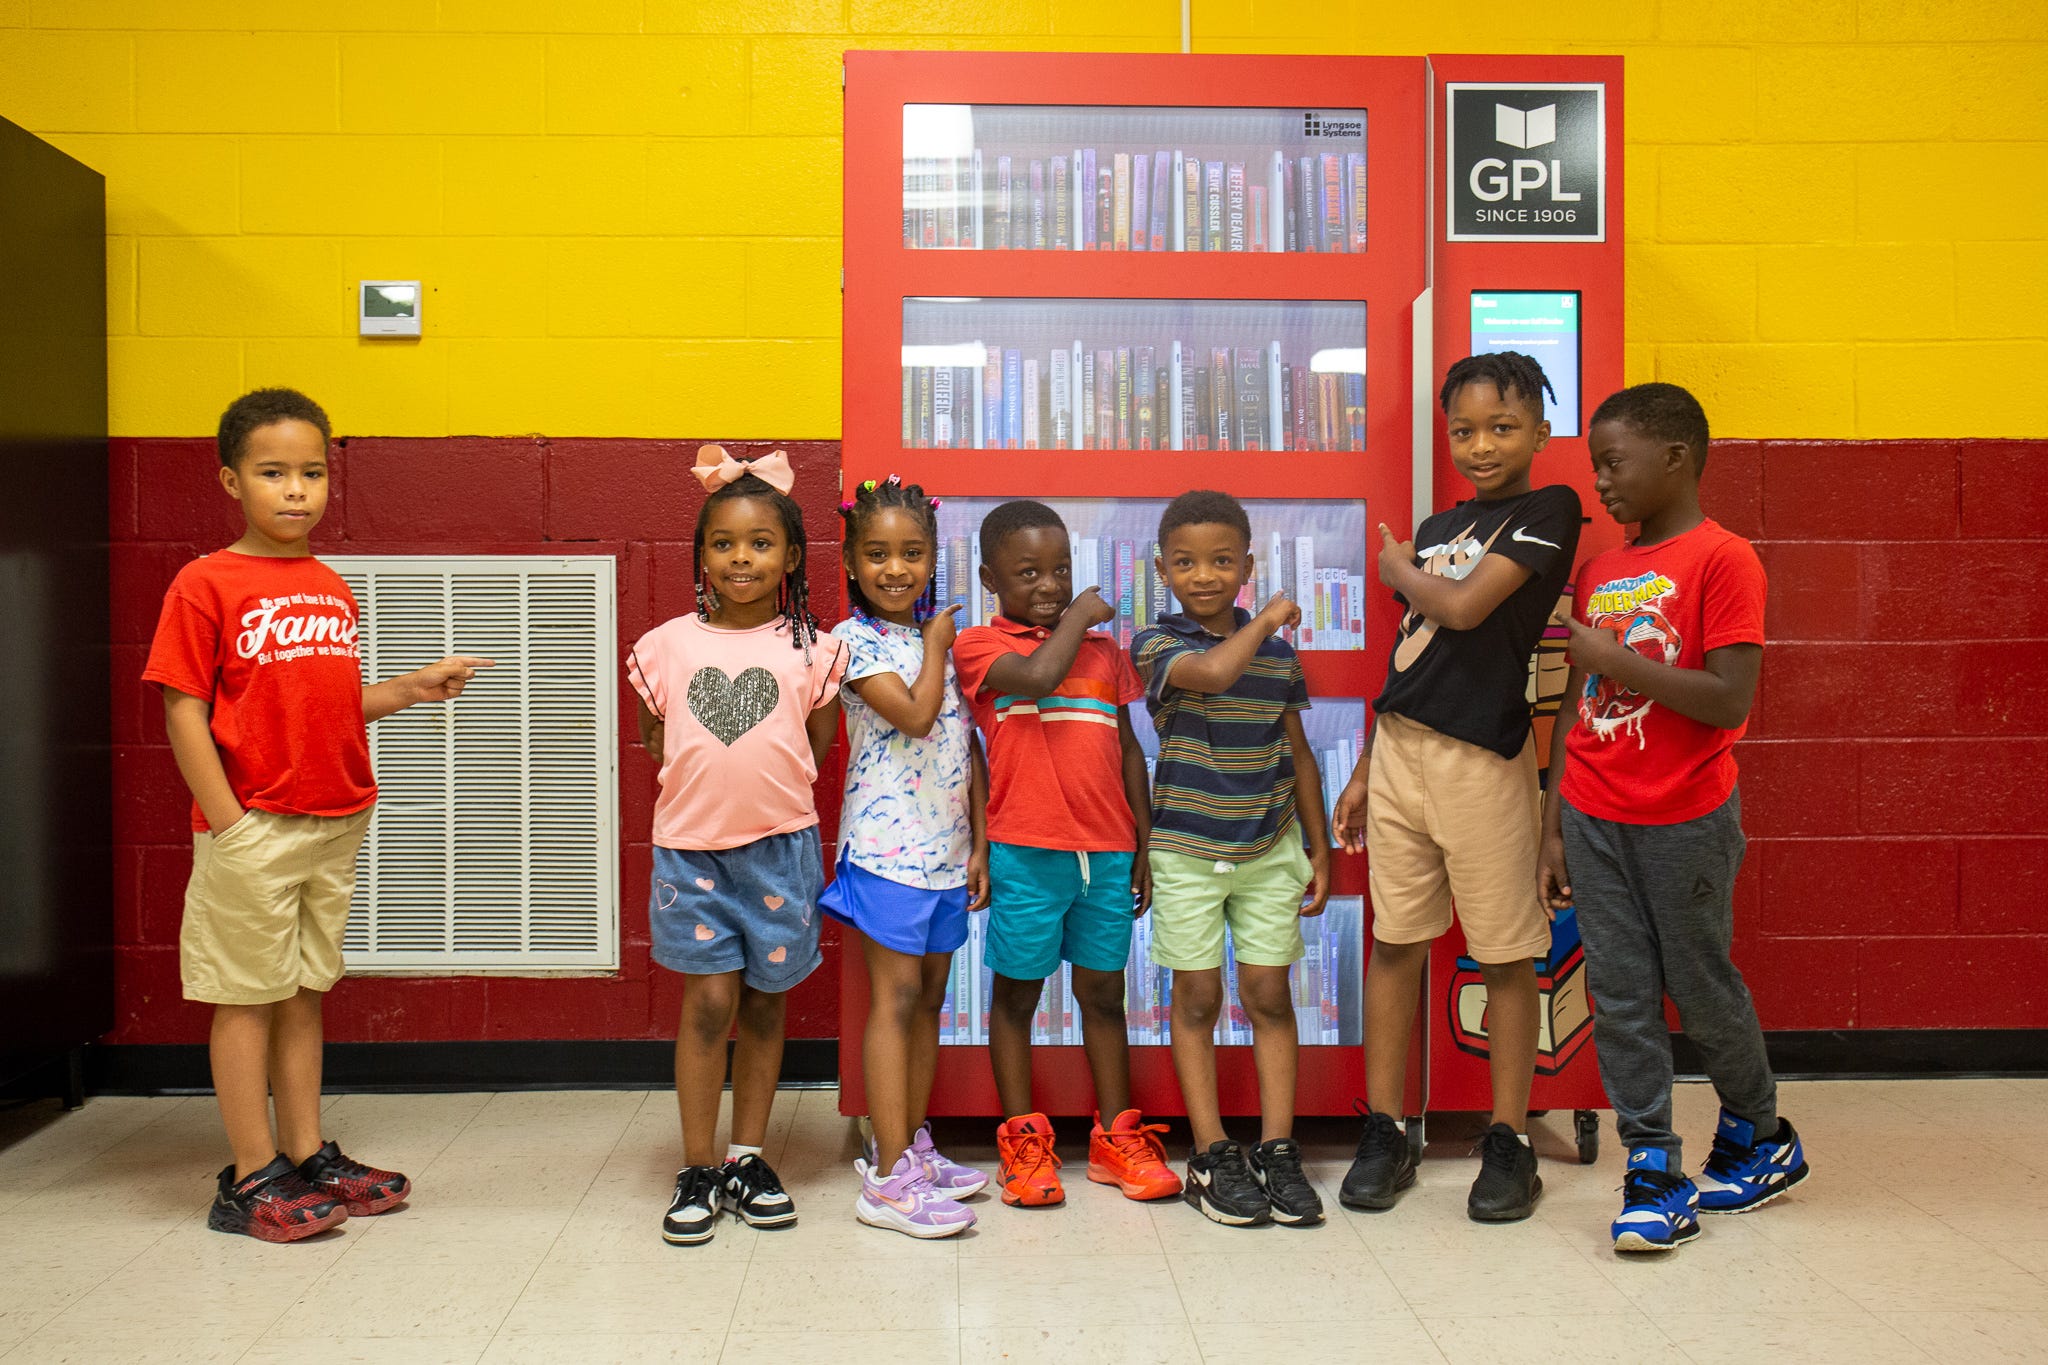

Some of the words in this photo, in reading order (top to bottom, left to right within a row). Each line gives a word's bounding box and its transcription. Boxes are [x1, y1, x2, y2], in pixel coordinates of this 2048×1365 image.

[1322, 121, 1361, 130] Lyngsoe
[1322, 129, 1361, 138] Systems
[1056, 170, 1066, 203] SANDRA
[1209, 168, 1219, 192] CLIVE
[1231, 168, 1243, 210] JEFFERY
[1469, 158, 1581, 202] GPL
[1209, 193, 1220, 231] CUSSLER
[1305, 192, 1313, 218] GRAHAM
[1475, 209, 1528, 222] SINCE
[1533, 209, 1577, 222] 1906
[1056, 206, 1066, 236] BROWN
[1230, 212, 1243, 251] DEAVER
[1085, 354, 1094, 384] CURTIS
[1119, 350, 1128, 381] JONATHAN
[936, 371, 950, 415] GRIFFIN
[1119, 382, 1128, 419] KELLERMAN
[1240, 394, 1260, 402] CITY
[1120, 543, 1131, 567] JOHN
[1120, 568, 1132, 616] SANDFORD
[1135, 573, 1144, 607] TOKEN
[1603, 572, 1656, 593] AMAZING
[259, 597, 274, 610] We
[274, 596, 291, 608] may
[290, 593, 304, 604] not
[302, 593, 319, 605] have
[257, 651, 273, 666] But
[274, 645, 315, 662] together
[316, 646, 330, 656] we
[329, 644, 346, 657] have
